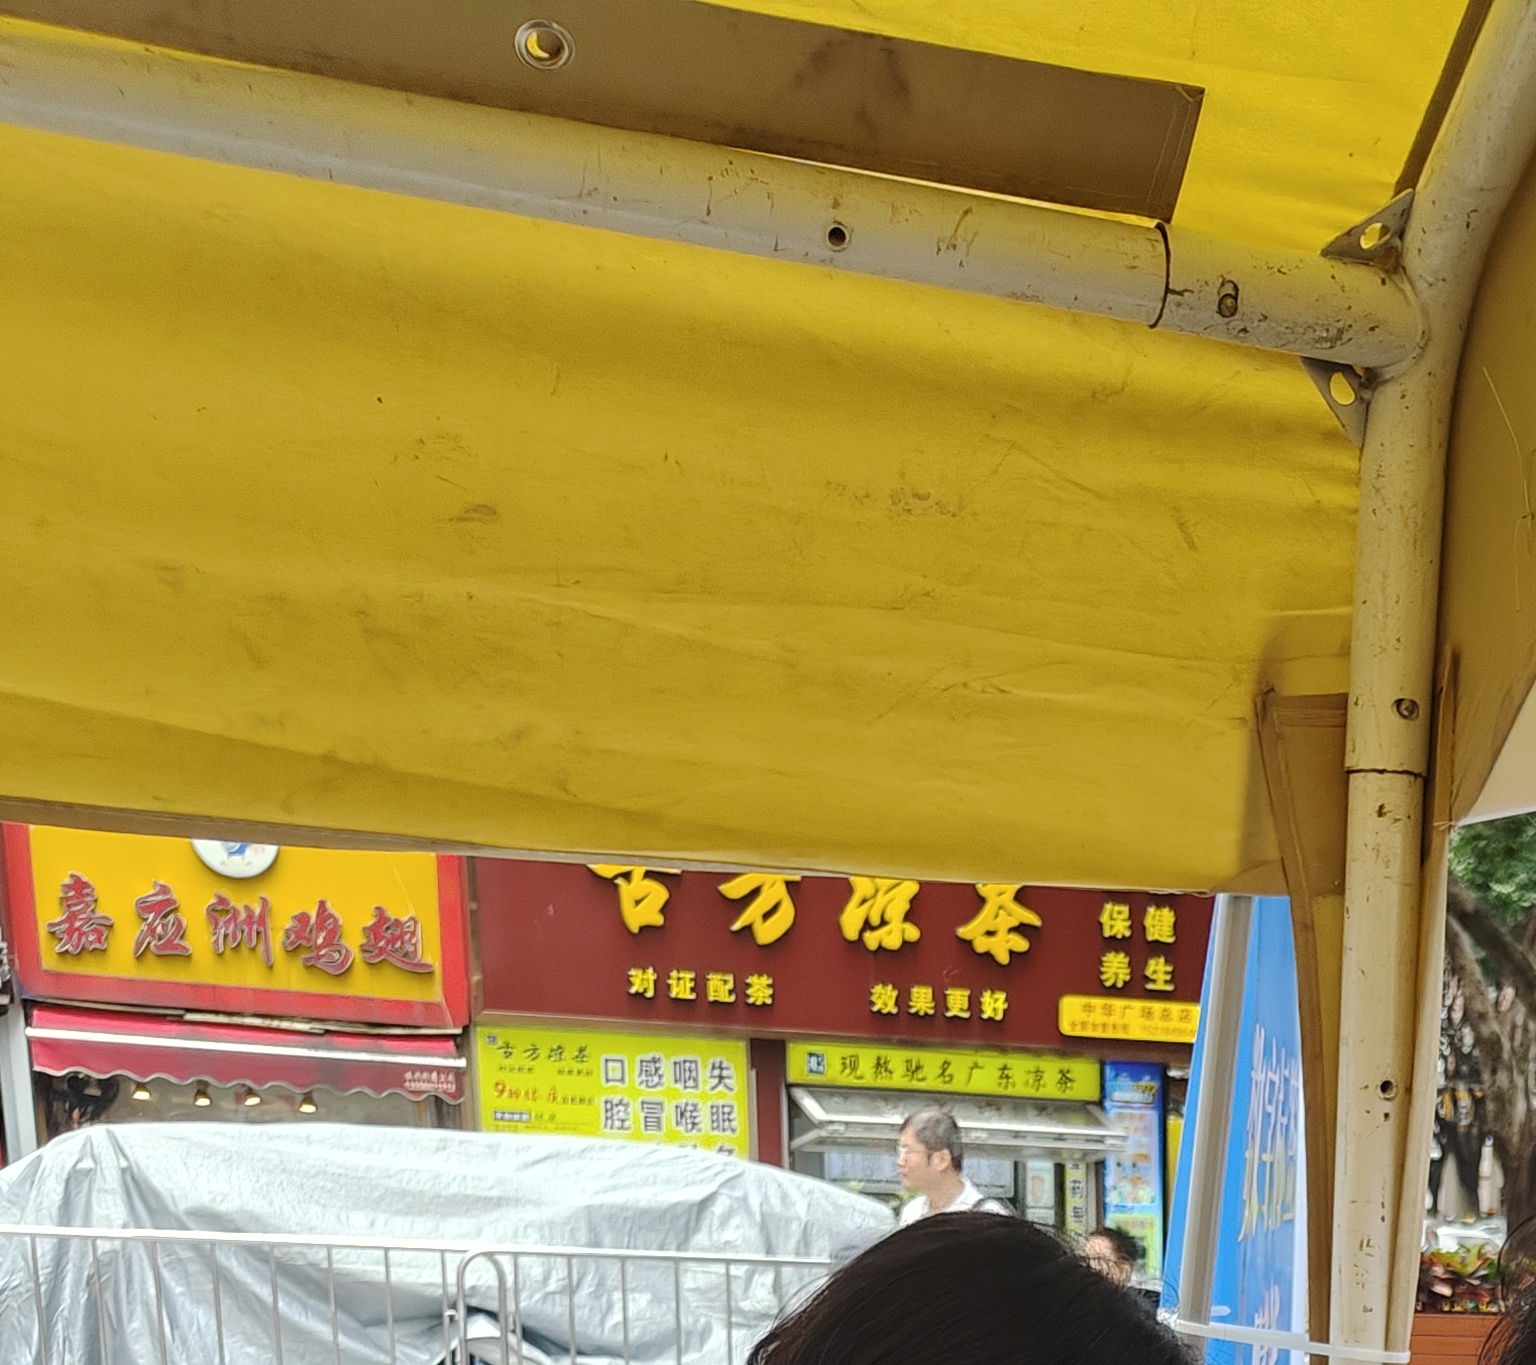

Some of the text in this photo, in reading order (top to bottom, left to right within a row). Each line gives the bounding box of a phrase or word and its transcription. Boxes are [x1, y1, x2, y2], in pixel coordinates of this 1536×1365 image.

[1099, 901, 1177, 943] 保健
[627, 966, 774, 1007] 对证配茶
[1100, 951, 1175, 991] 养生
[870, 983, 1009, 1022] 效果更好
[838, 1054, 1078, 1094] 现熬驰名广东凉茶
